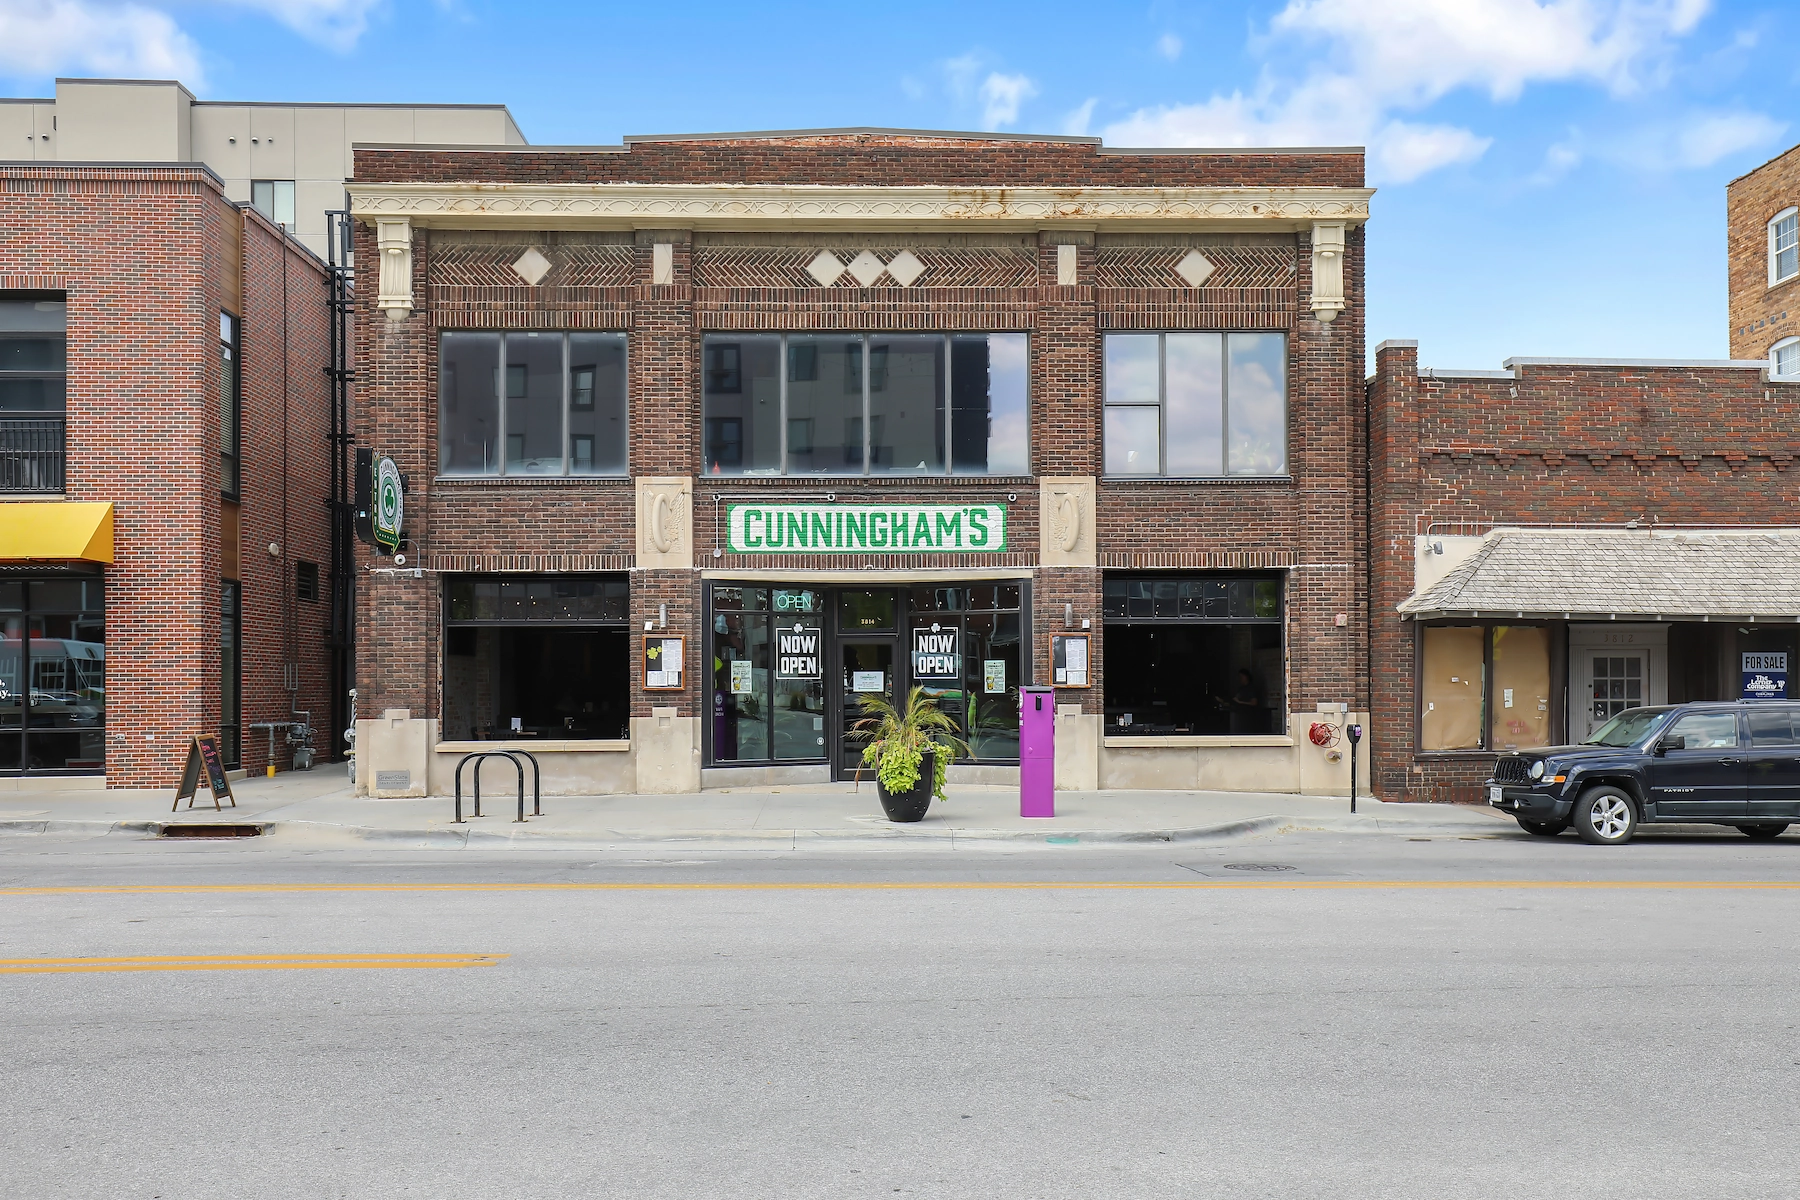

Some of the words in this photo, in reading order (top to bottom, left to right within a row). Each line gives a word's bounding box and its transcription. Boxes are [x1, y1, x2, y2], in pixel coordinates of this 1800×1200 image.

[743, 508, 988, 548] CUNNINGHAM'S
[777, 595, 812, 609] OPEN
[780, 635, 817, 654] NOW
[918, 635, 954, 653] NOW
[1603, 633, 1634, 643] 3812
[780, 656, 817, 674] OPEN
[918, 656, 954, 674] OPEN
[1745, 656, 1762, 669] FOR
[1763, 656, 1784, 669] SALE
